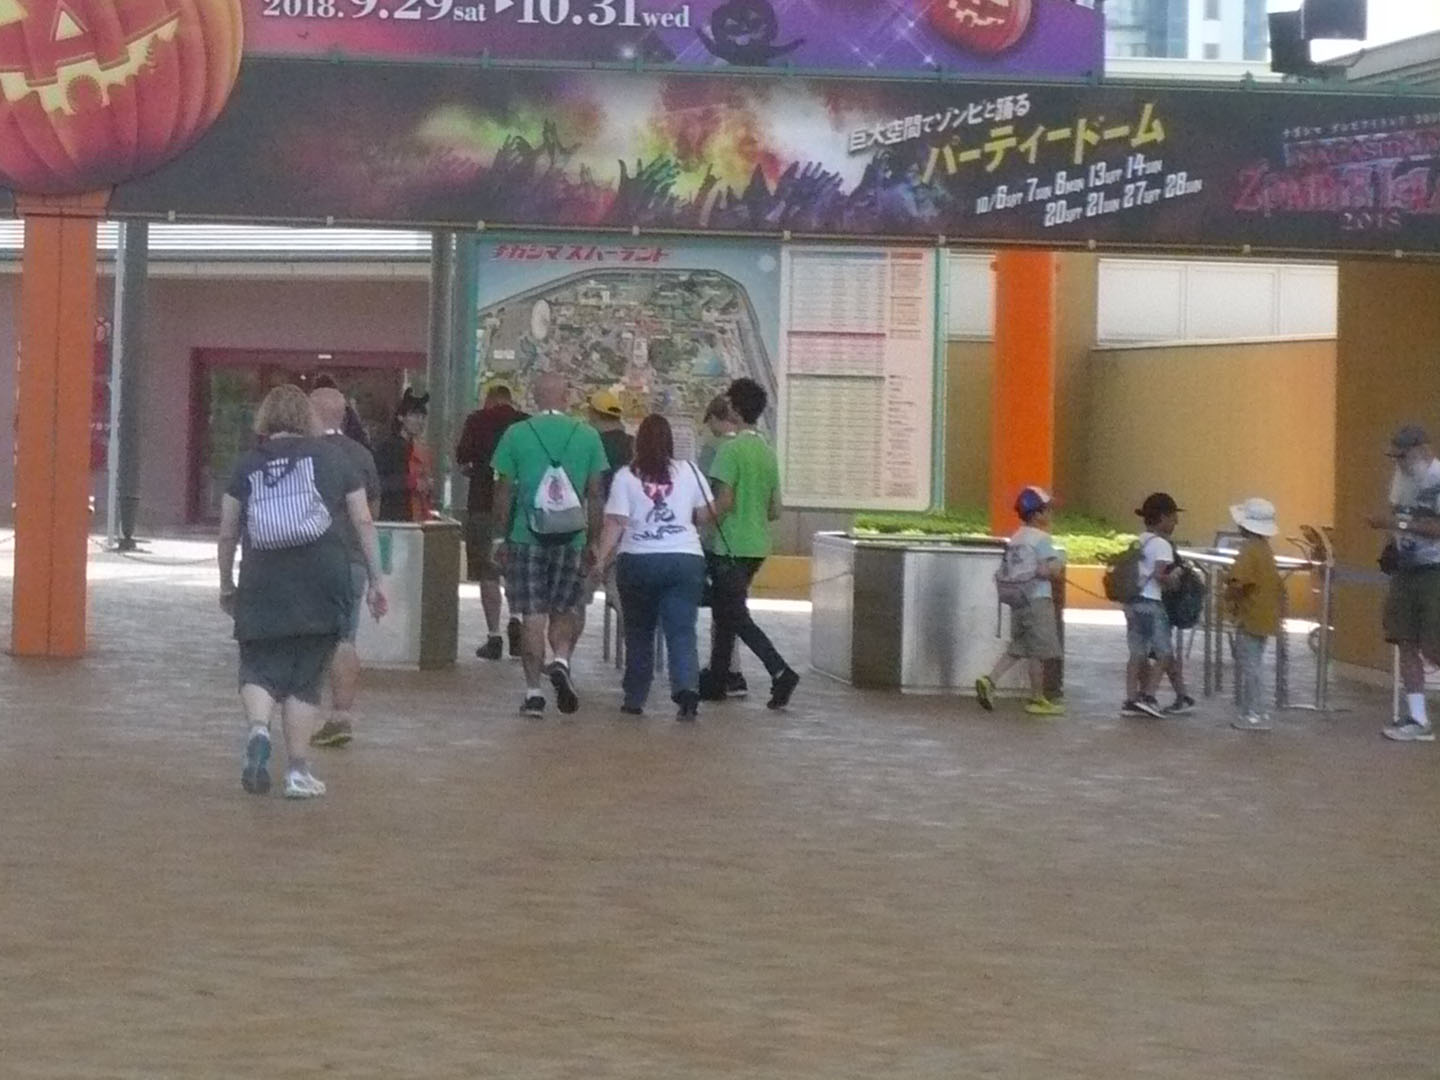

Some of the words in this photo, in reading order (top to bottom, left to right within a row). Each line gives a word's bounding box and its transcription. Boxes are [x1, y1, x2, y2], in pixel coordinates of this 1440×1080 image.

[921, 103, 1166, 184] パーティードーム
